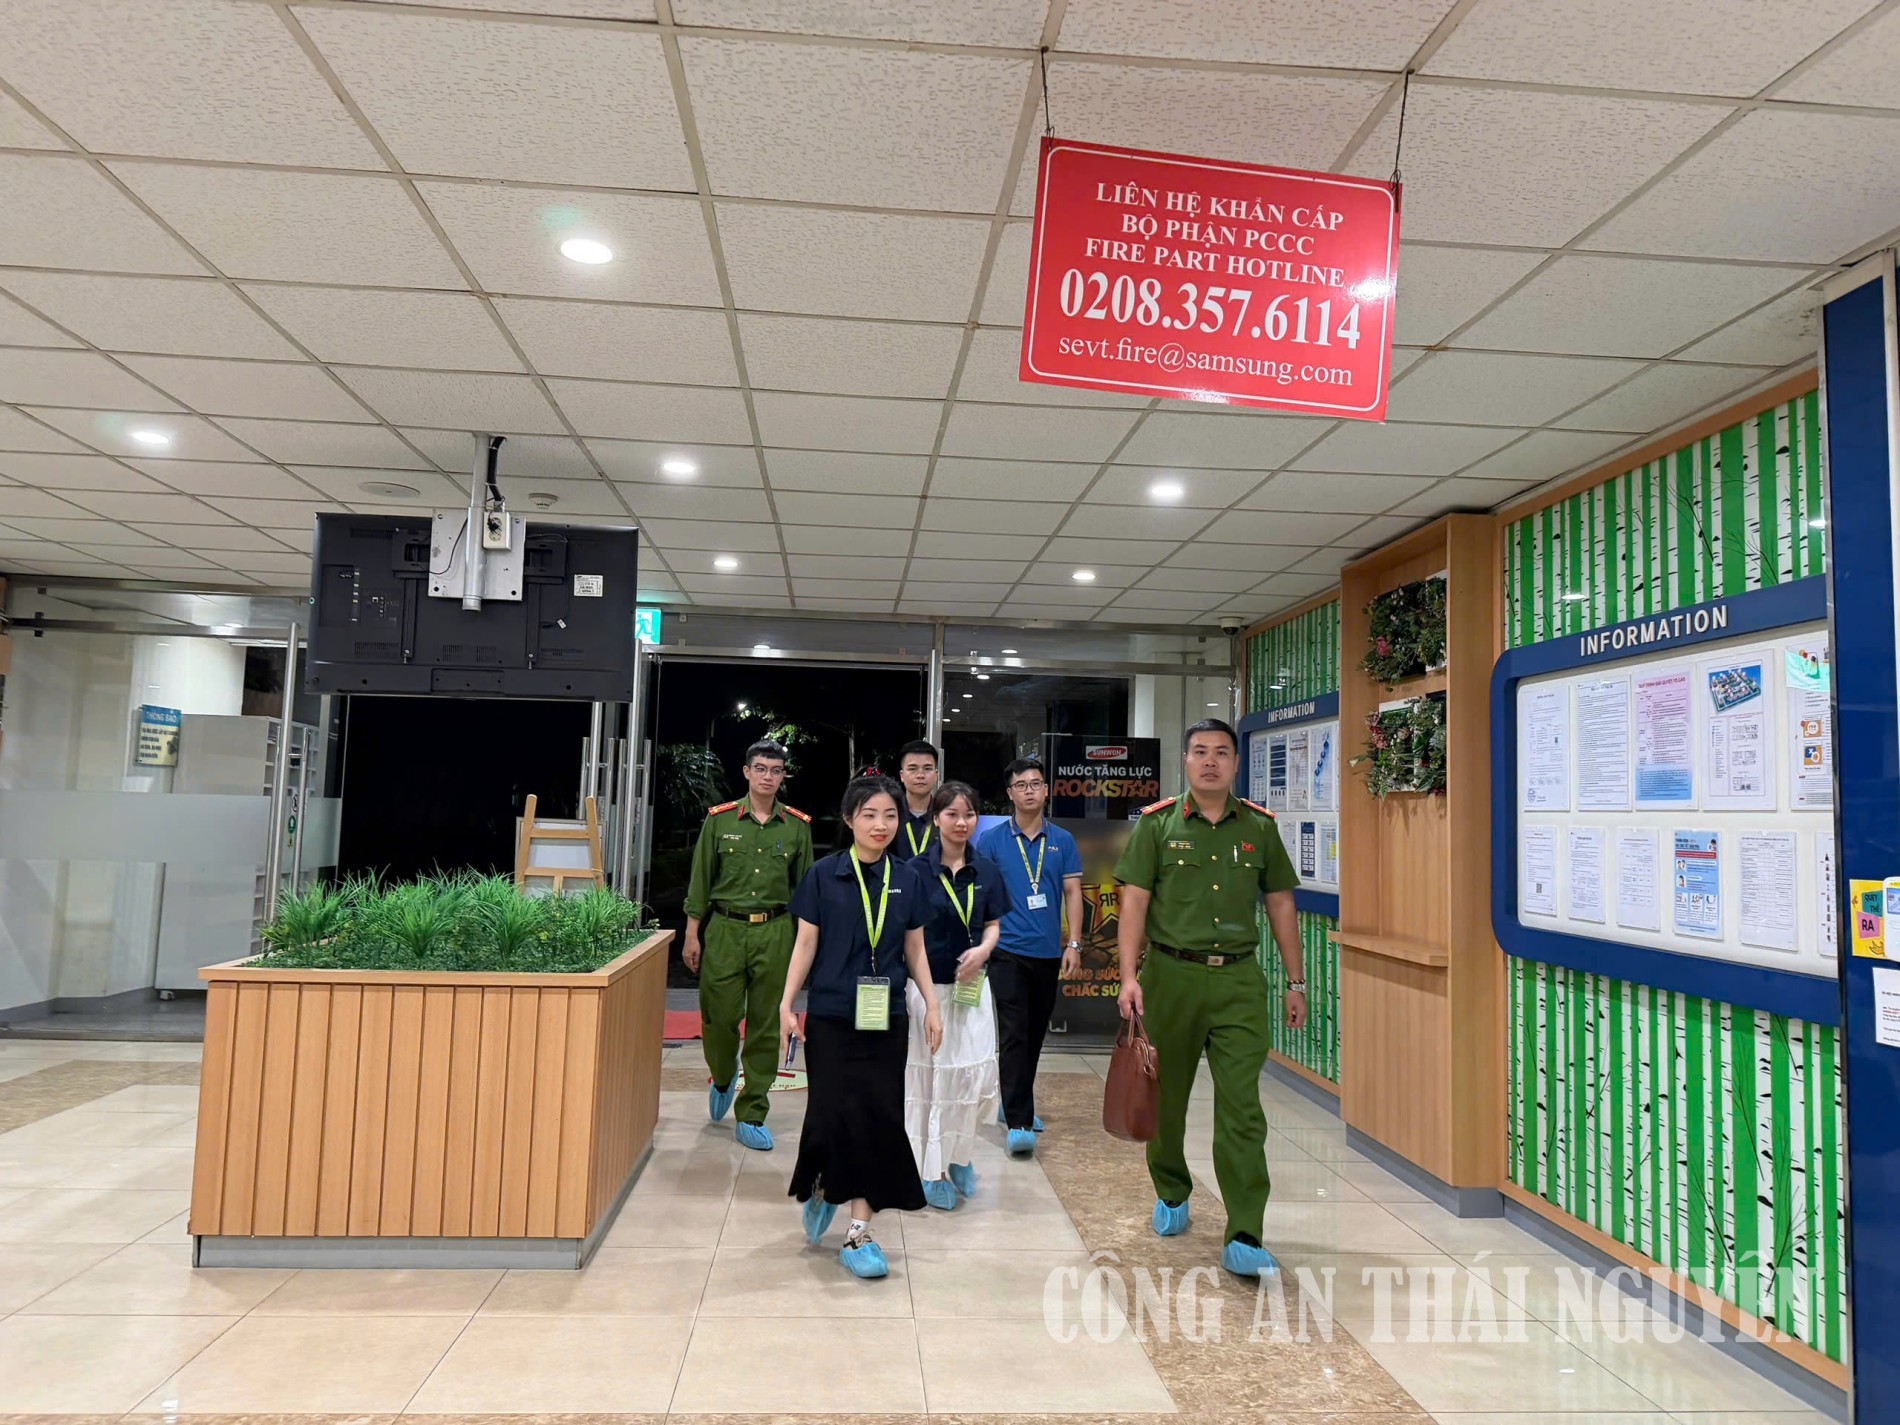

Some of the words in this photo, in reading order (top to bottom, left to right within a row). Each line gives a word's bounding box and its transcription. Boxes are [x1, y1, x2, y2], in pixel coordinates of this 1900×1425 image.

[1096, 181, 1159, 208] LIÊN
[1165, 191, 1201, 218] HỆ
[1209, 196, 1285, 224] KHẨN
[1291, 204, 1344, 231] CẤP
[1121, 213, 1158, 241] BỘ
[1164, 219, 1237, 248] PHẬN
[1243, 229, 1315, 255] PCCC
[1084, 237, 1146, 263] FIRE
[1153, 245, 1221, 272] PART
[1226, 255, 1345, 288] HOTLINE
[1060, 268, 1361, 349] 0208.357.6114
[1058, 336, 1353, 387] sevt.fire@samsung.com
[1580, 604, 1729, 657] INFORMATION
[1268, 701, 1315, 723] INFORMATION
[1053, 779, 1159, 798] ROCKSTAR
[1058, 763, 1092, 777] NƯỚC
[1094, 764, 1126, 777] TĂNG
[1128, 765, 1153, 780] LỰC
[1861, 919, 1875, 932] RA
[1101, 981, 1121, 997] SỨ
